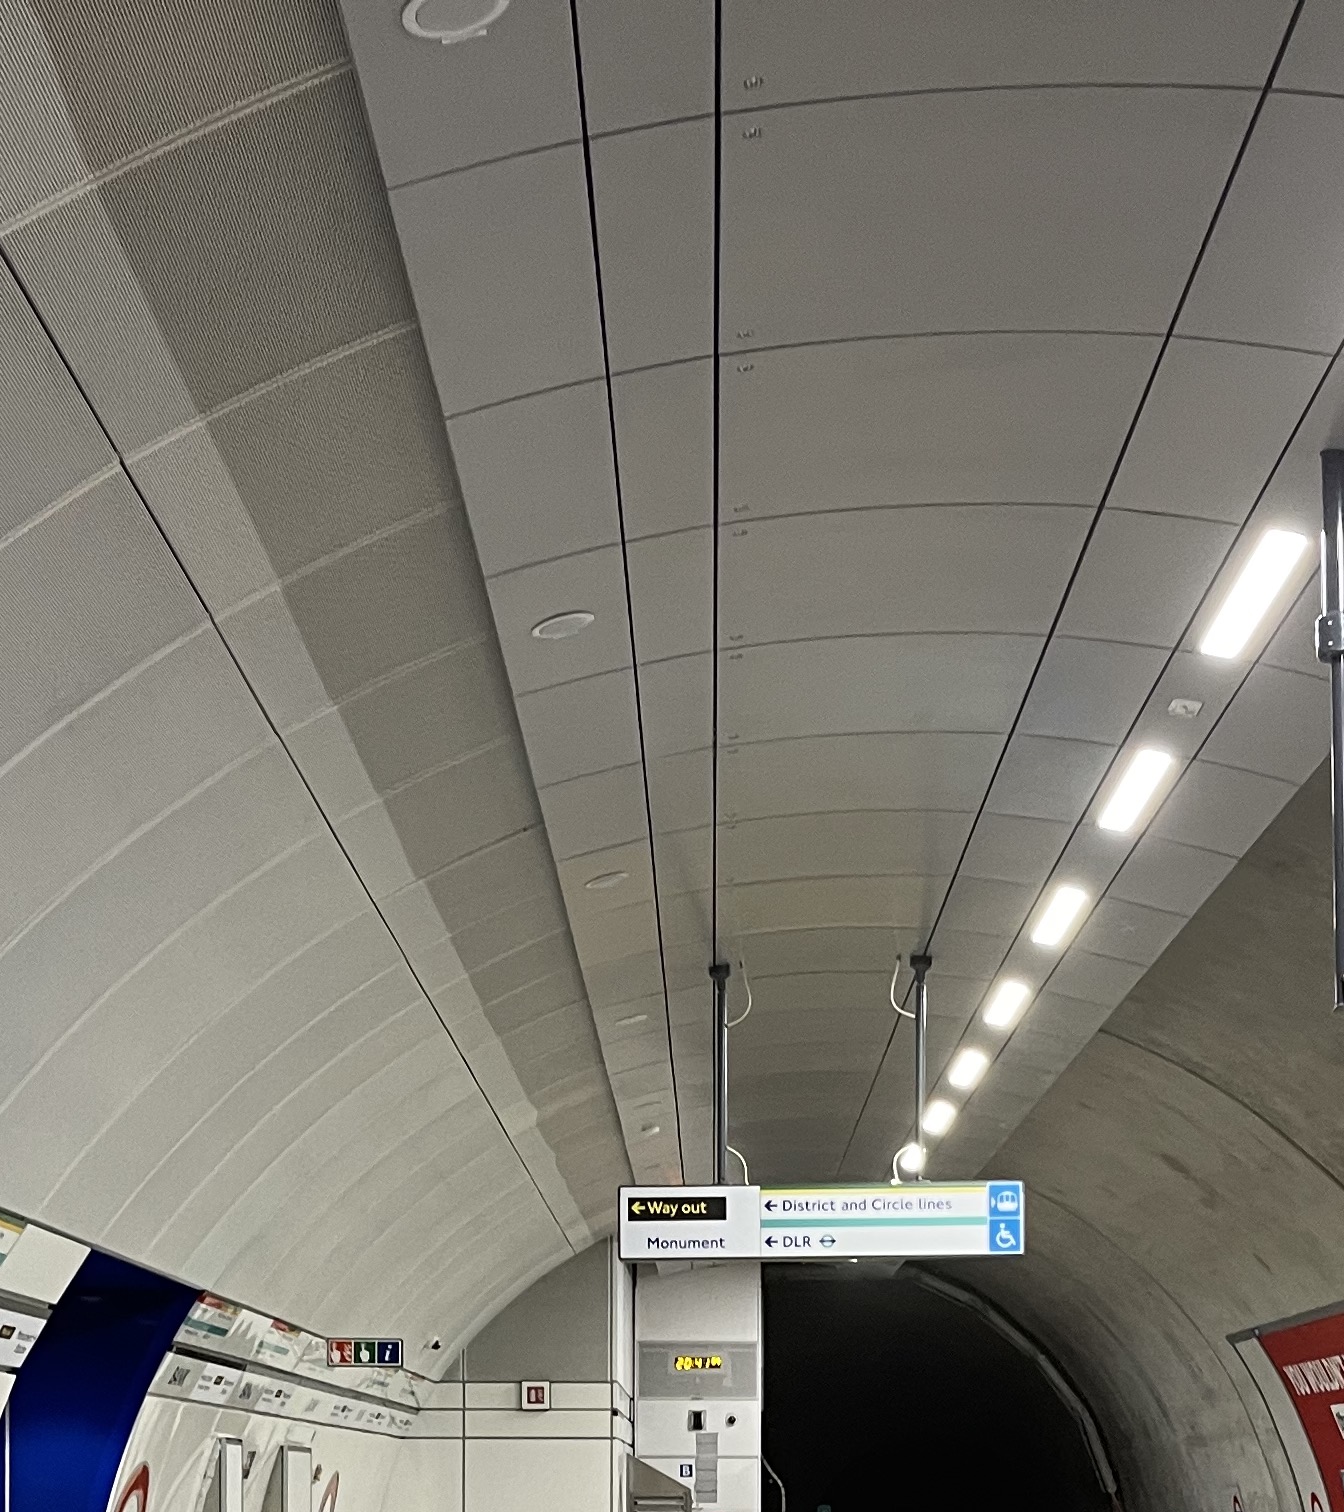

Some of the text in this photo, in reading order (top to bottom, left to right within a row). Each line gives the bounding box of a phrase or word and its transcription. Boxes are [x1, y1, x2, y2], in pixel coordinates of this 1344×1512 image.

[647, 1201, 707, 1217] Way out
[782, 1197, 952, 1212] District and Circle lines
[647, 1237, 726, 1249] Monument
[782, 1236, 812, 1248] DLR
